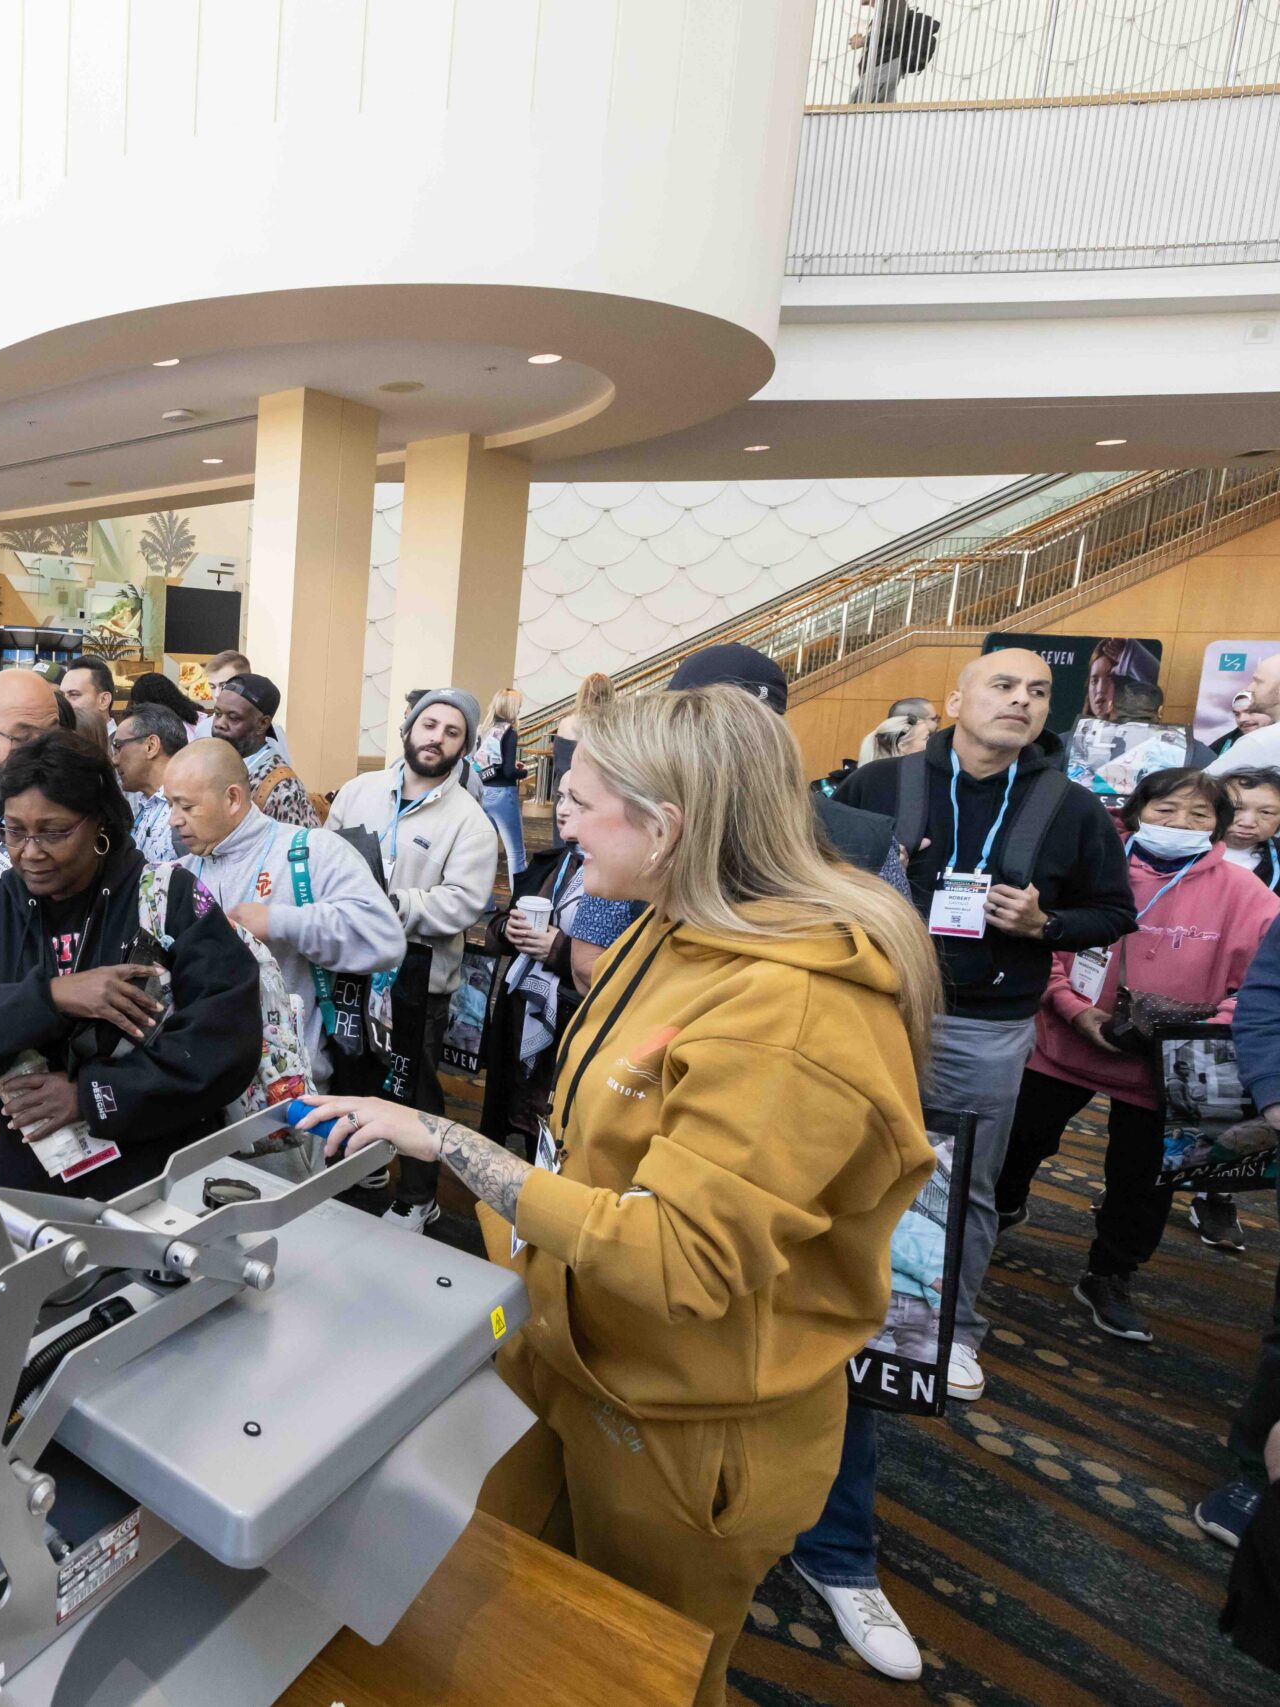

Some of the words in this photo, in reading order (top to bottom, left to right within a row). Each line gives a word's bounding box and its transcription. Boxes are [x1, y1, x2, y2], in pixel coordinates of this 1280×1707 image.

[1040, 649, 1075, 666] SEVEN
[298, 881, 309, 903] EVEN
[443, 1047, 479, 1071] EVEN
[91, 1081, 108, 1120] DESIGNS
[849, 1357, 936, 1404] VEN
